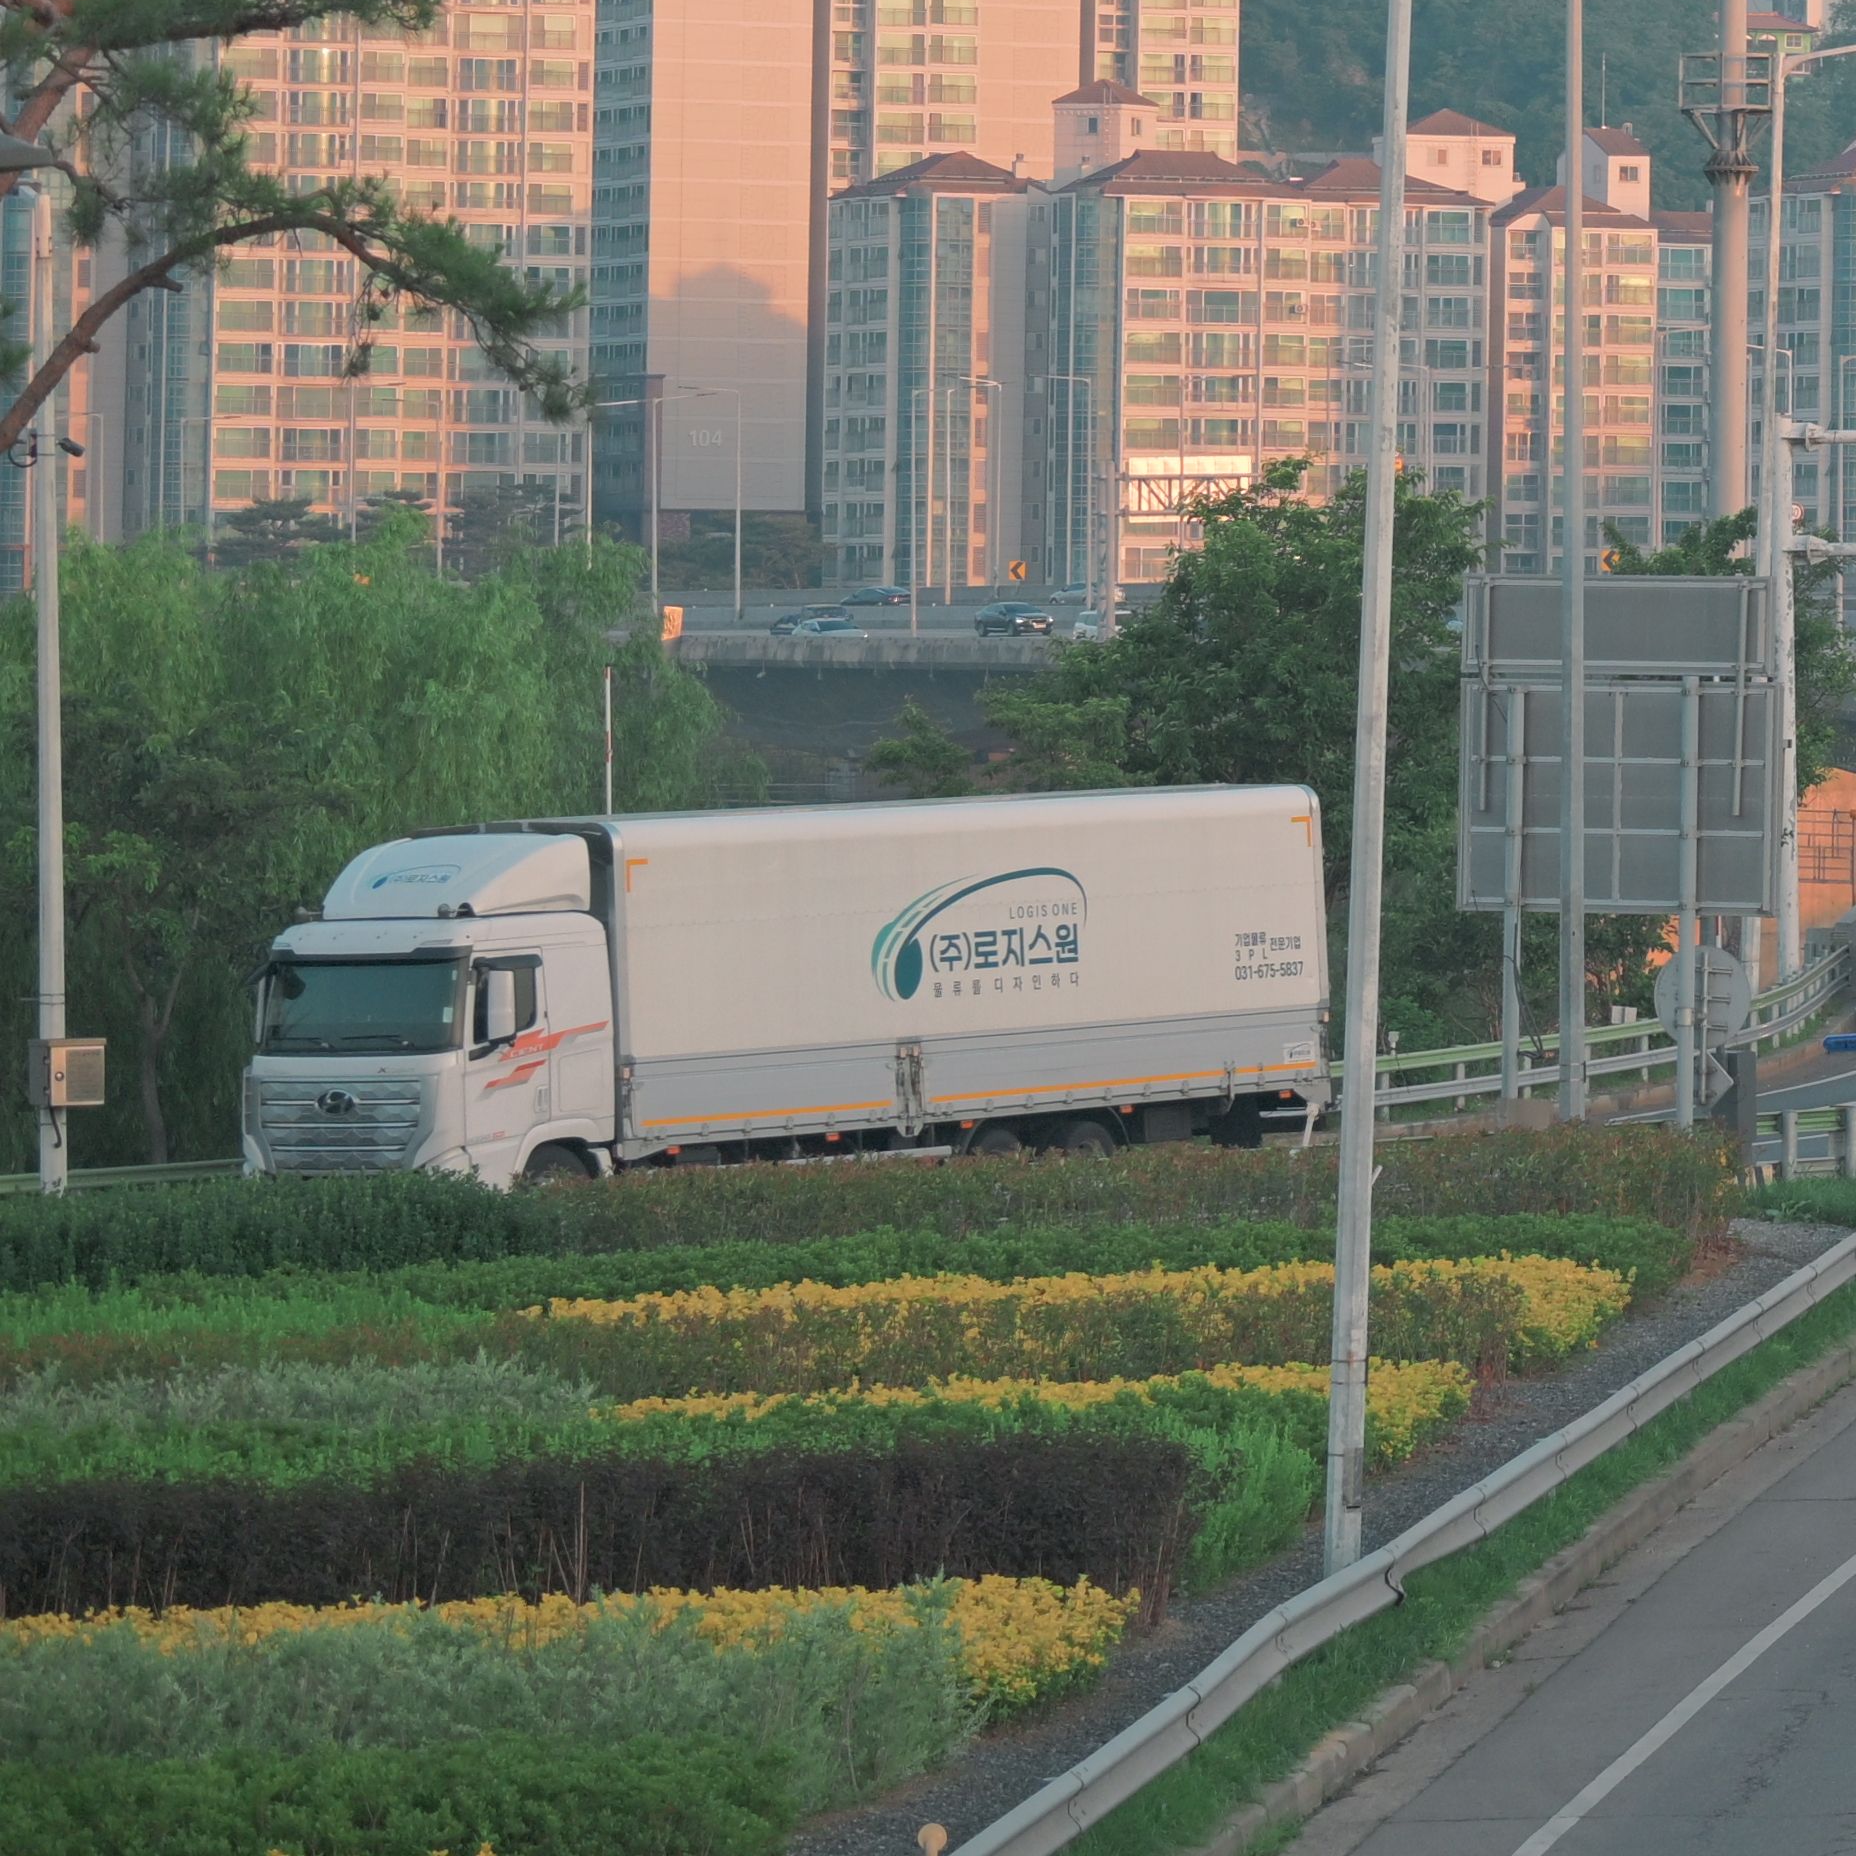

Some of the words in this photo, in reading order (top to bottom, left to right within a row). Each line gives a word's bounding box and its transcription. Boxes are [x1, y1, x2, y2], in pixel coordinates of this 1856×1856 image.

[689, 430, 721, 446] 104
[930, 923, 1079, 973] (주)로지스원
[1235, 961, 1303, 980] 031-675-5837
